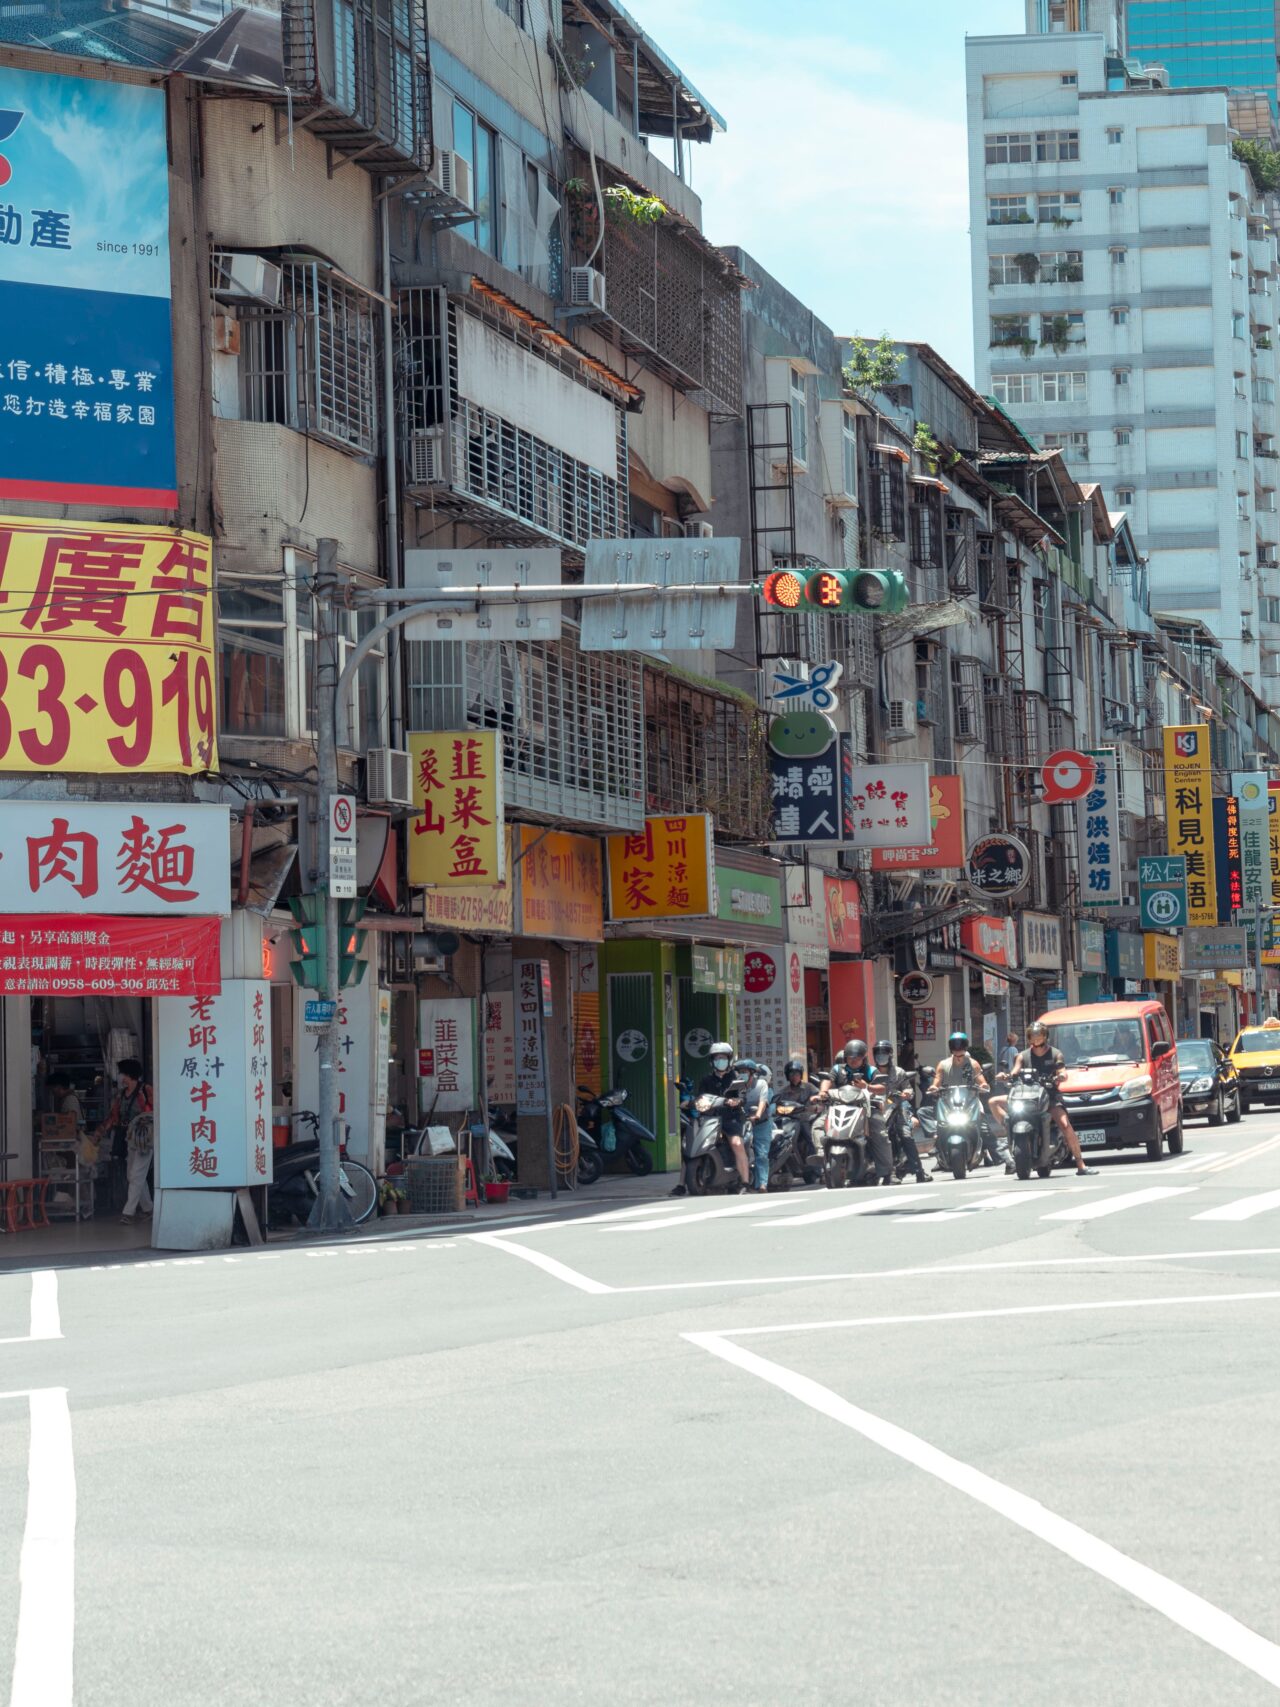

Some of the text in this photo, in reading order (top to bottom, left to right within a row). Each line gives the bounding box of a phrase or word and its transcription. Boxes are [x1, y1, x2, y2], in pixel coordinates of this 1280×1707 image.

[97, 240, 160, 256] since 1991
[3, 394, 155, 426] 您打造幸福家園
[415, 748, 445, 836] 象山
[0, 815, 199, 903] 肉麵
[623, 821, 658, 911] 周家
[665, 818, 690, 909] 四川涼麵
[921, 847, 940, 856] JSP
[971, 867, 1023, 885] 米之鄉
[1141, 862, 1184, 882] 松仁
[1175, 786, 1207, 909] 科見美語
[52, 978, 143, 990] 0958-609-306
[180, 1057, 224, 1079] 原汁
[189, 1080, 218, 1177] 牛肉麵
[253, 1080, 267, 1176] 牛肉麵
